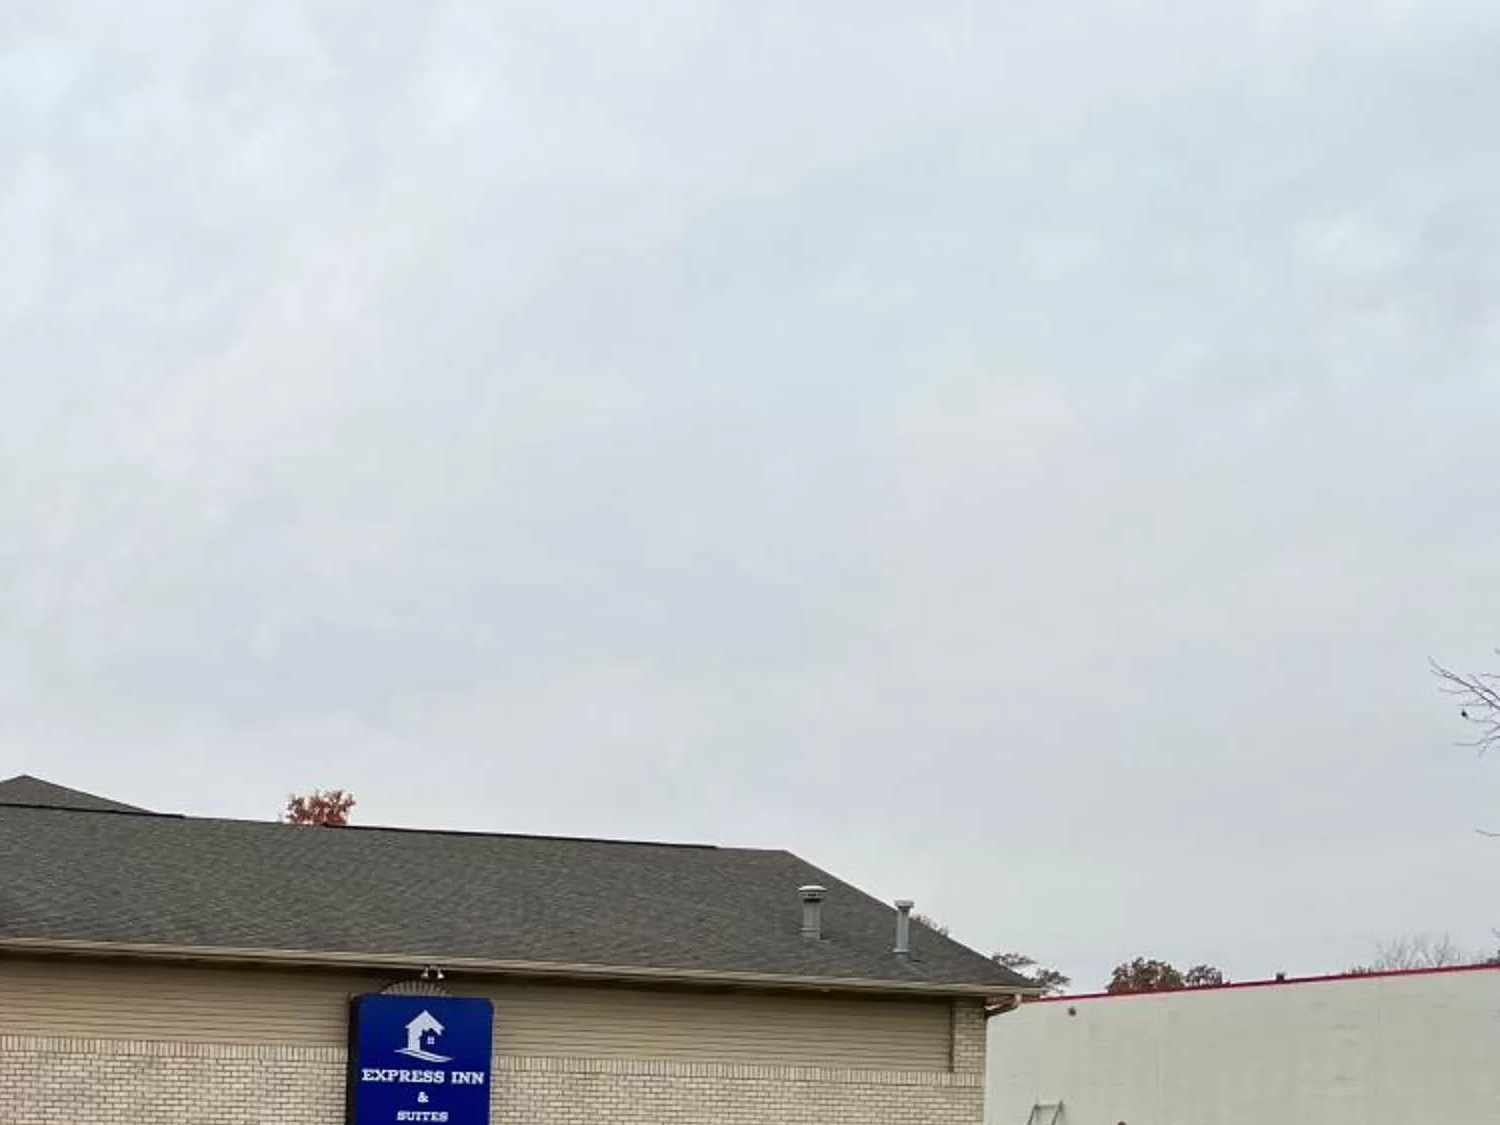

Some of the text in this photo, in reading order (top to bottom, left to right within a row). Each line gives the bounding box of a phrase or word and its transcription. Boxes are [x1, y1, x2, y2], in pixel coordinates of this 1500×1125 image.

[361, 1068, 485, 1085] EXPRESS INN
[417, 1091, 429, 1103] &
[396, 1110, 449, 1122] SUITES
